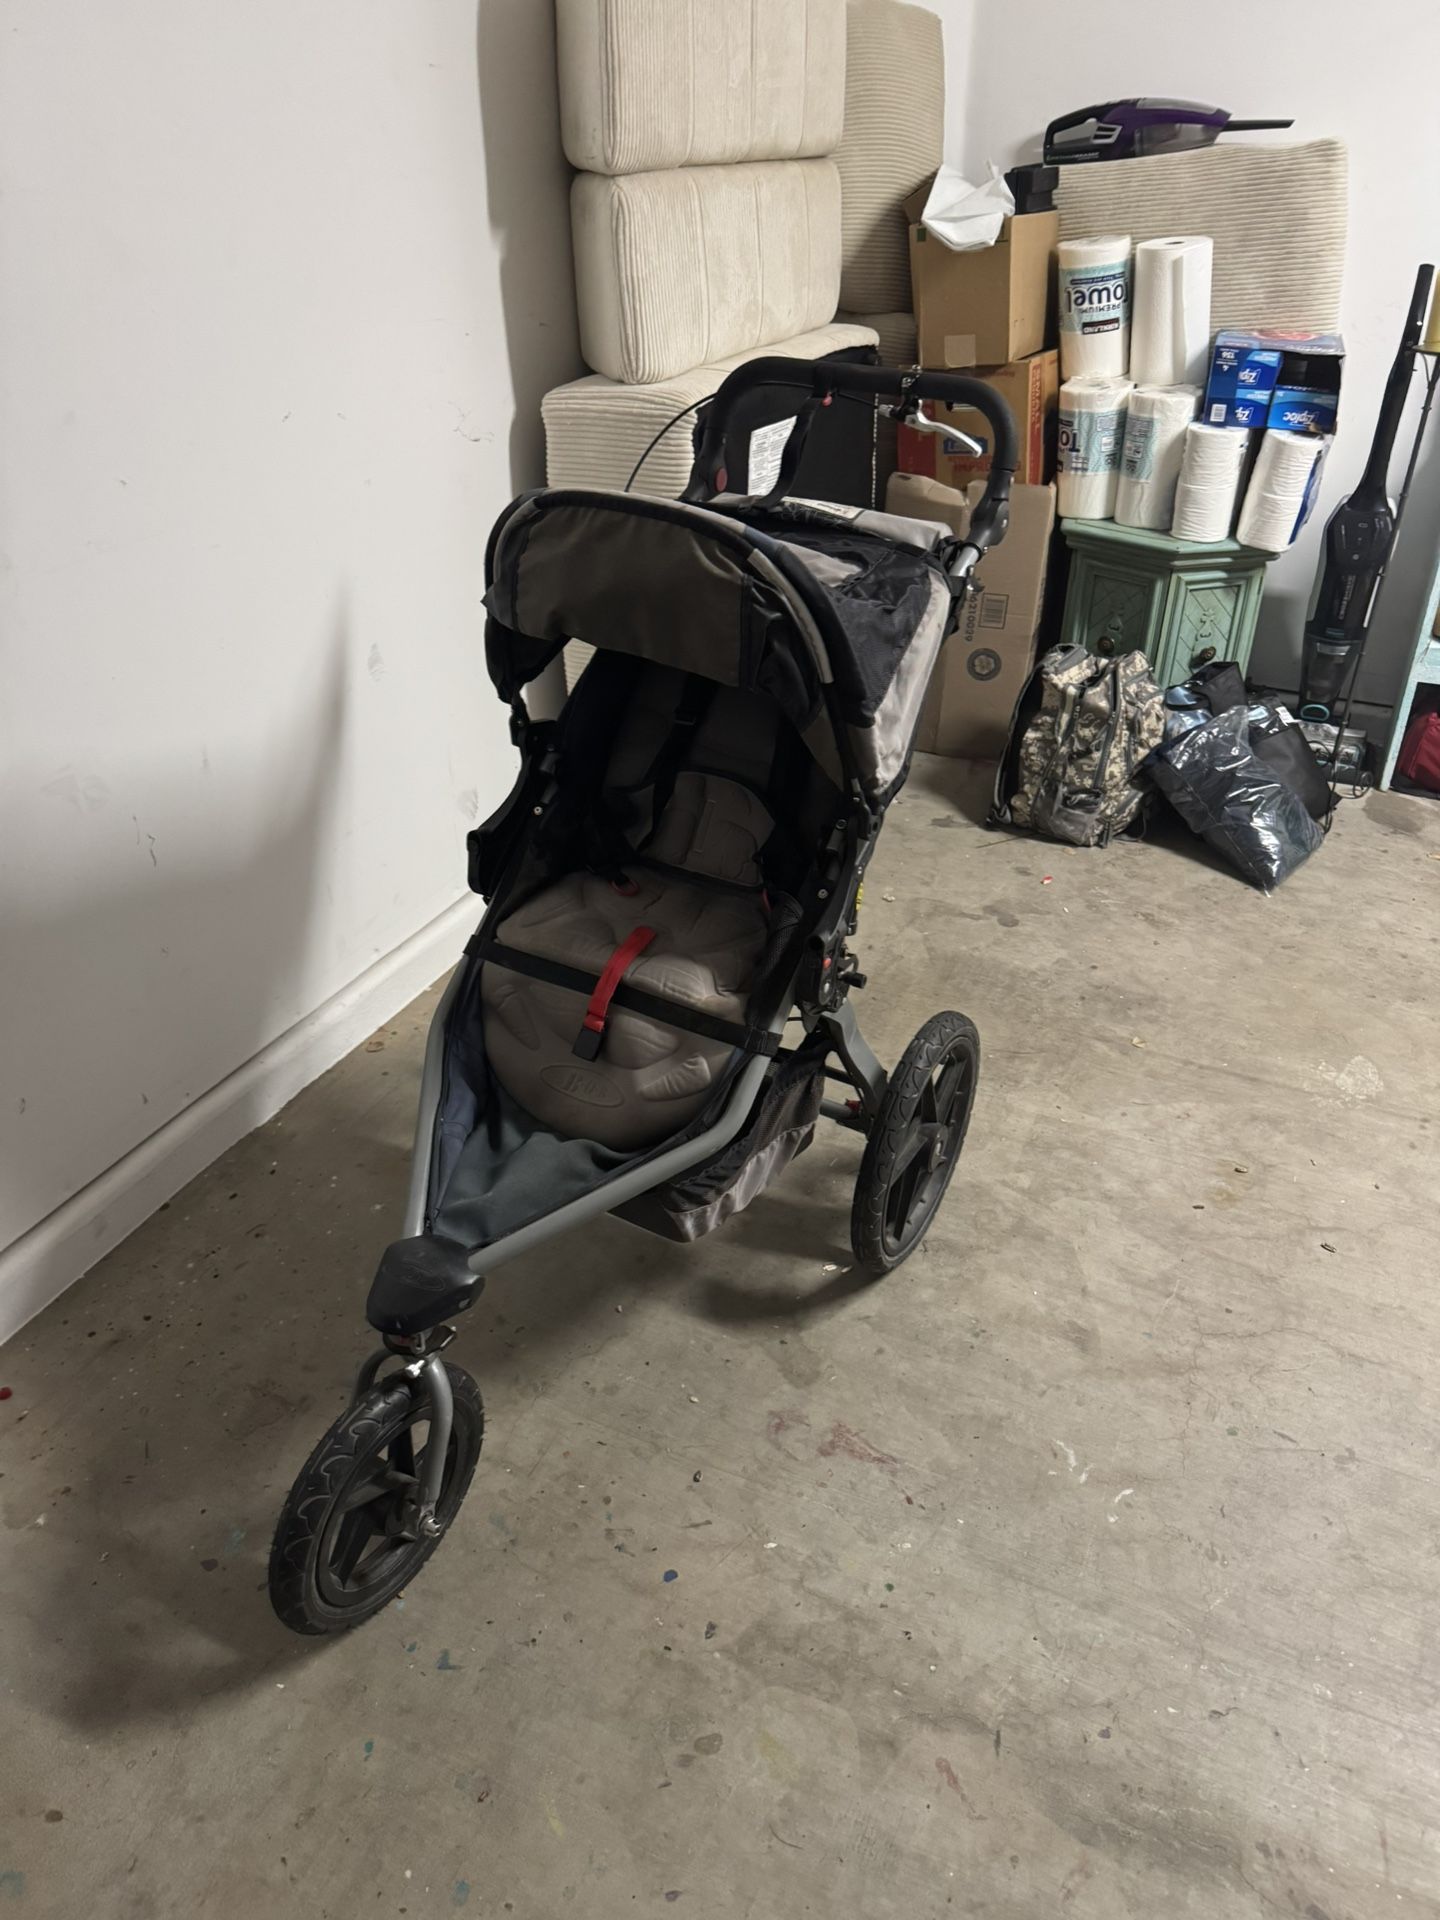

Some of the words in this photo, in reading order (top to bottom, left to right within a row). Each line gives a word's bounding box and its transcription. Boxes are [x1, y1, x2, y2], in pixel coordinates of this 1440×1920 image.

[1064, 281, 1129, 313] Towel
[1081, 302, 1121, 314] PREMIUM
[1282, 410, 1316, 426] Ziploc
